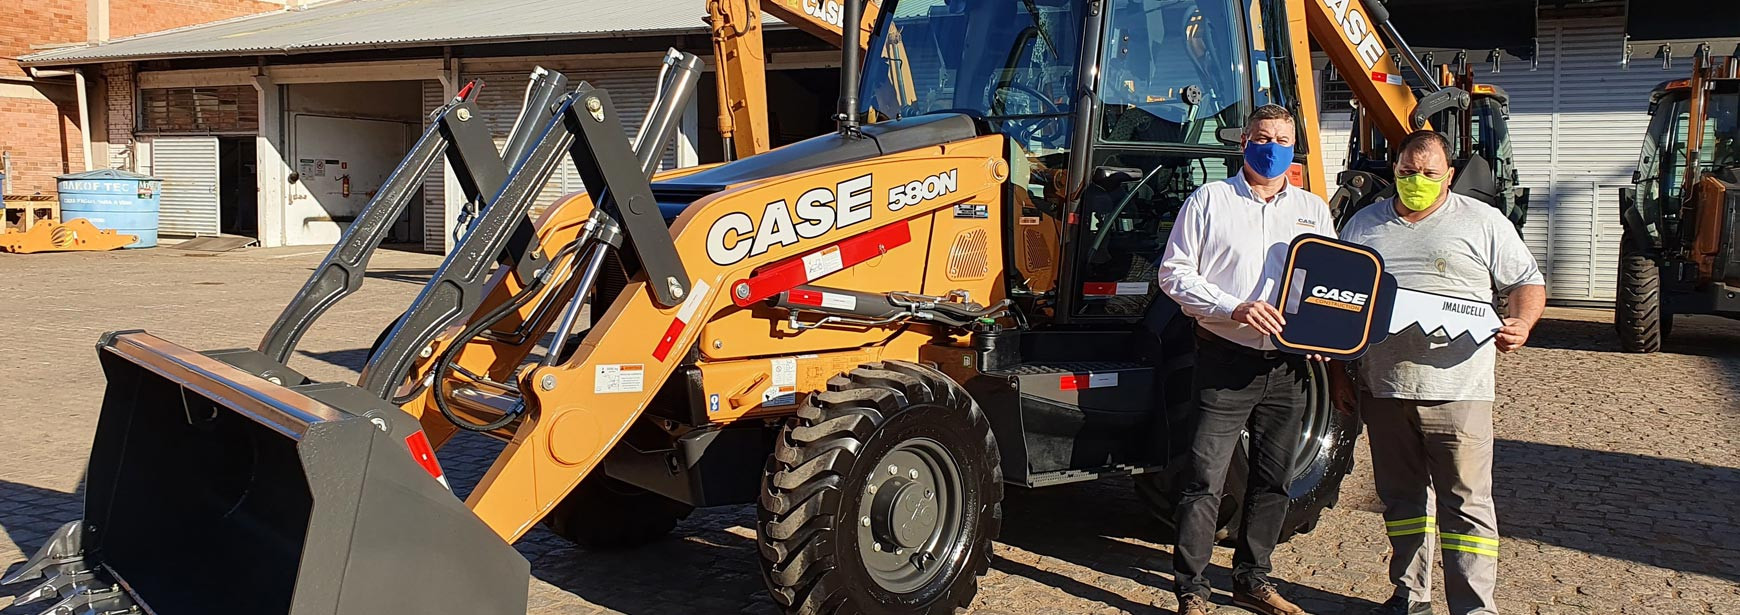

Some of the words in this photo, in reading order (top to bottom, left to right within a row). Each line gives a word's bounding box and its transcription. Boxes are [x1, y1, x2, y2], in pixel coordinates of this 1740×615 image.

[1323, 0, 1385, 70] ASE
[104, 182, 129, 192] TEC
[706, 173, 873, 266] CASE
[887, 168, 958, 212] 580N
[1311, 285, 1368, 306] CASE
[1315, 298, 1360, 311] CONSTRUCTION
[1441, 301, 1486, 318] JMALUCELLI
